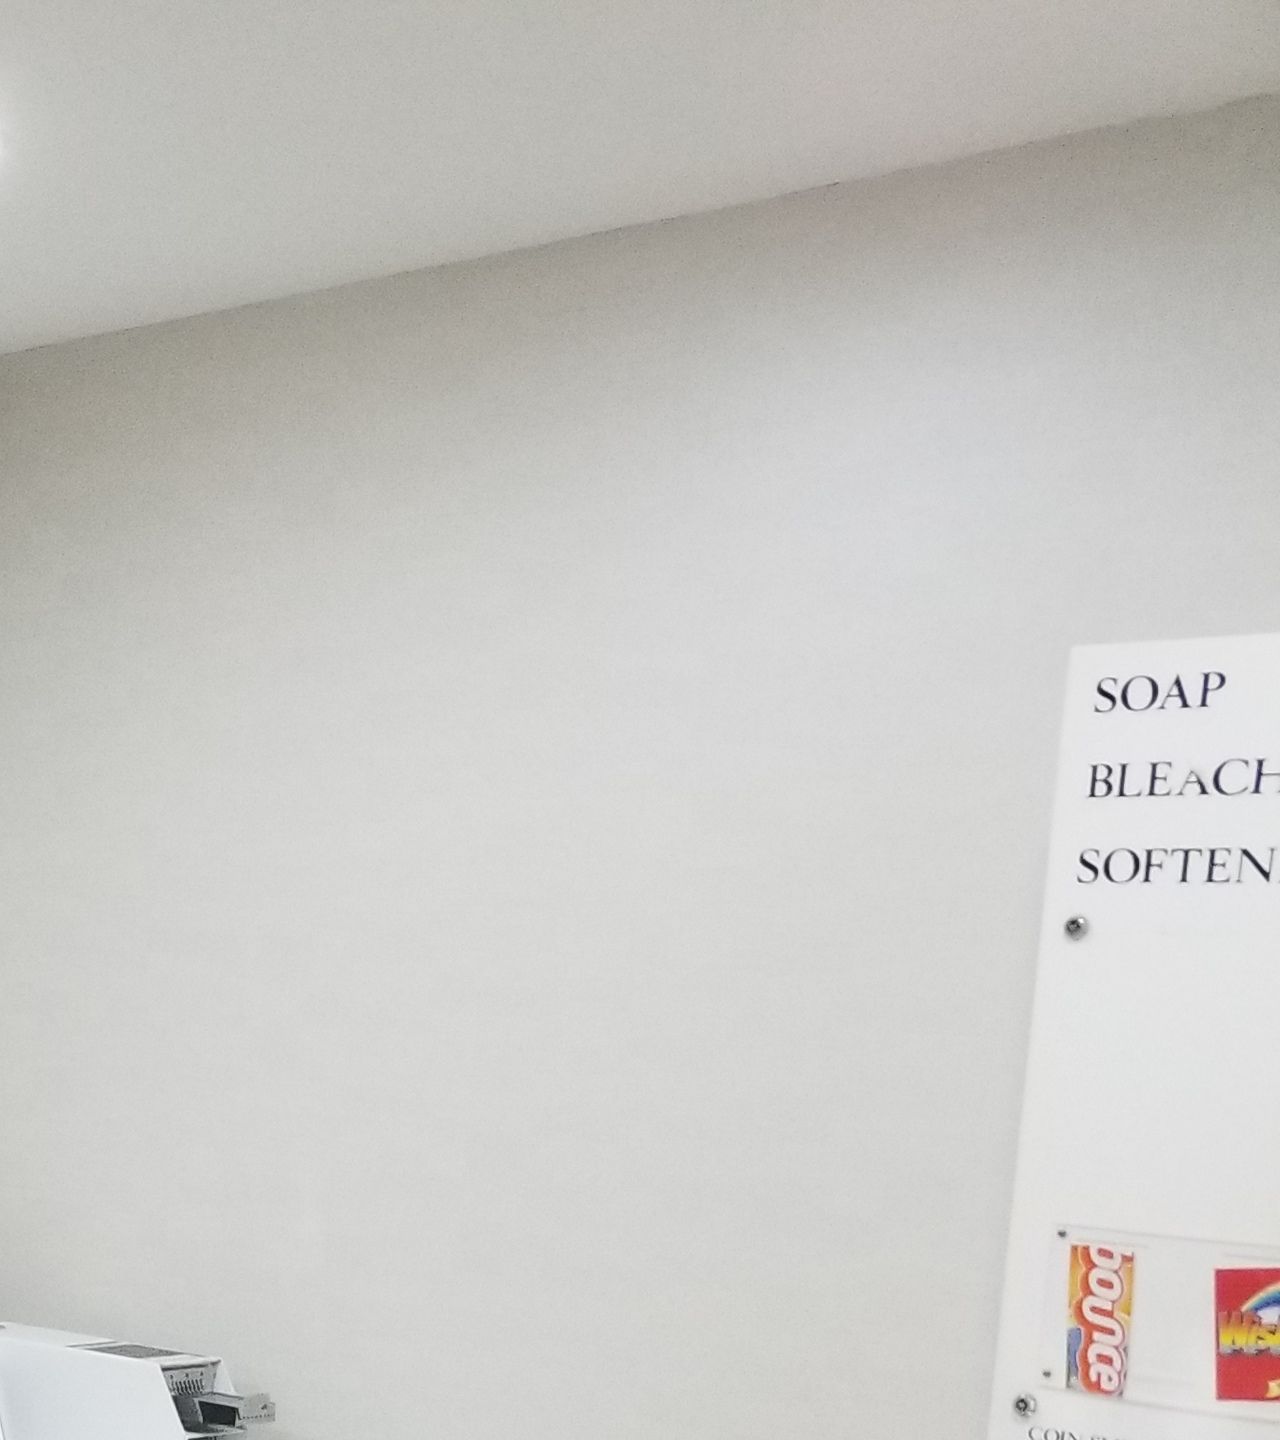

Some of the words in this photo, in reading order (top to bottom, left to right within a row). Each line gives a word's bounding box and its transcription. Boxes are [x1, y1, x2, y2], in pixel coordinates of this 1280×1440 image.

[1093, 671, 1226, 713] SOAP
[1087, 758, 1280, 798] BLEACH
[1076, 848, 1280, 884] SOFTEN
[1082, 1244, 1132, 1393] bounce
